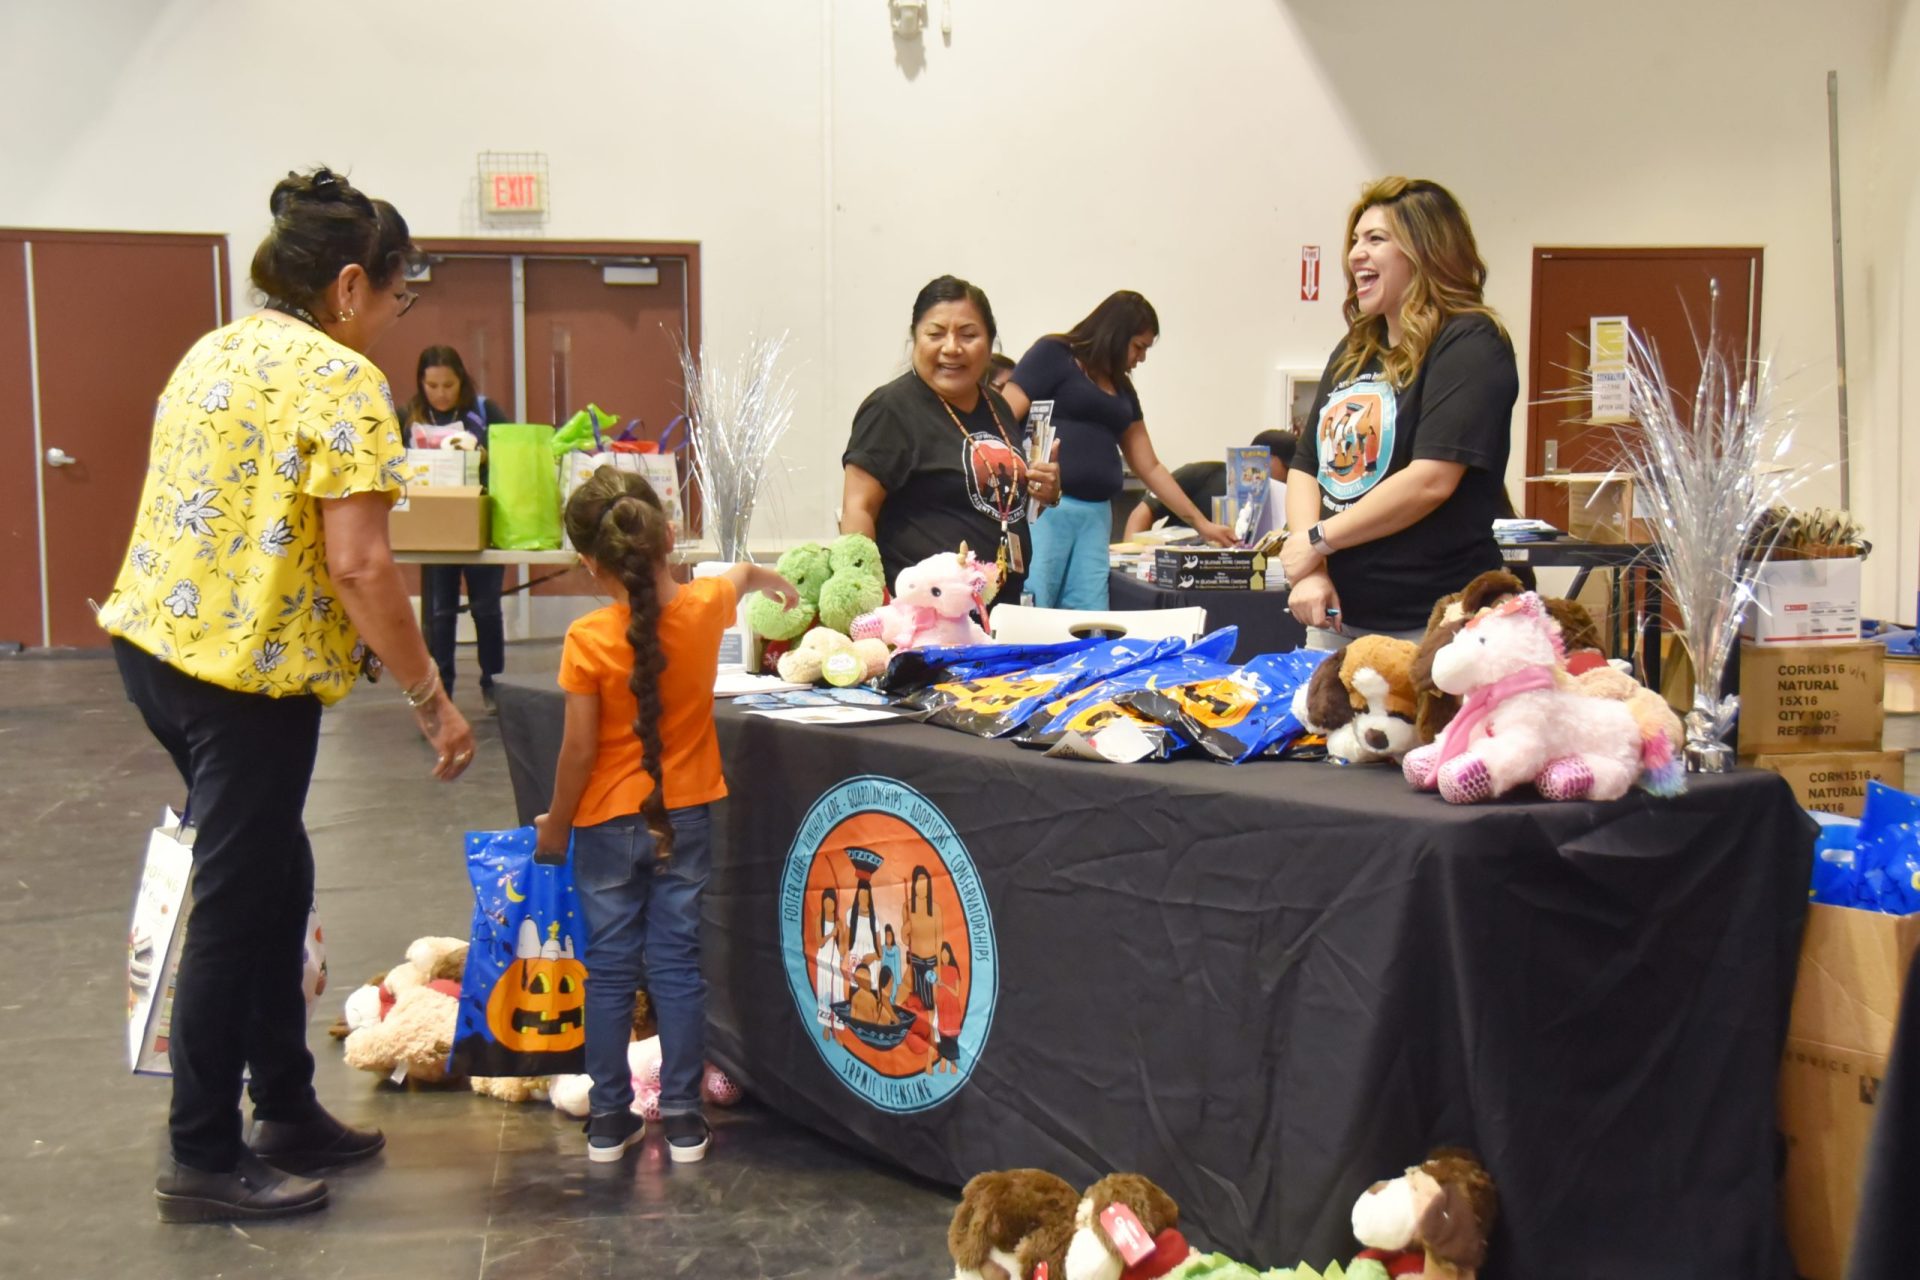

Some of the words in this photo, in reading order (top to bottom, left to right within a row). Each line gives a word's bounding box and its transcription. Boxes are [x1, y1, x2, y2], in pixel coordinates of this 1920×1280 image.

[494, 175, 536, 208] EXIT
[1778, 663, 1846, 676] CORK1516
[1777, 679, 1840, 691] NATURAL
[1778, 695, 1818, 706] 15X16
[1778, 710, 1804, 721] QTY
[1811, 710, 1831, 721] 100
[1809, 770, 1871, 783] CORK1516
[846, 784, 903, 811] GUARDIANSHIPS
[1808, 785, 1865, 799] NATURAL
[825, 796, 842, 823] CARE
[802, 813, 826, 852] KINSHIP
[909, 801, 951, 849] ADOPTIONS
[791, 853, 808, 883] CARE
[783, 882, 802, 923] FOSTER
[950, 853, 990, 963] CONSERVATORSHIPS
[843, 1057, 877, 1096] SRPMIC
[880, 1078, 933, 1105] LICENSING
